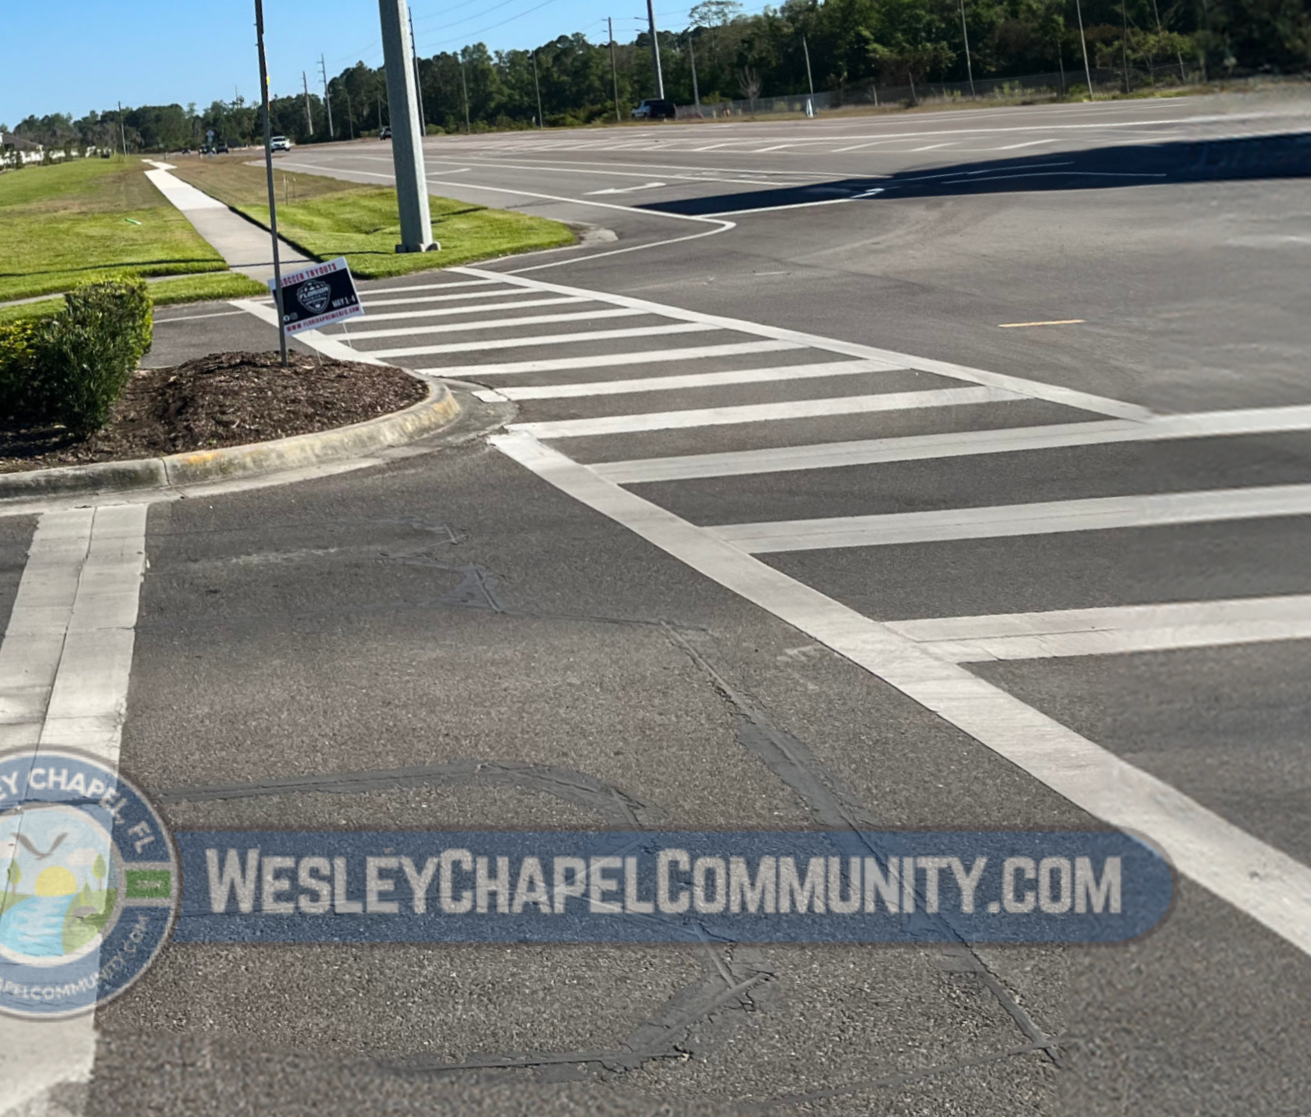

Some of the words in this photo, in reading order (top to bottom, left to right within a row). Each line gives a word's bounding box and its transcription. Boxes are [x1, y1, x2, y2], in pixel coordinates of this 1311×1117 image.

[280, 273, 305, 287] SOCCER
[305, 262, 338, 278] TRYOUTS
[332, 298, 345, 308] MAY
